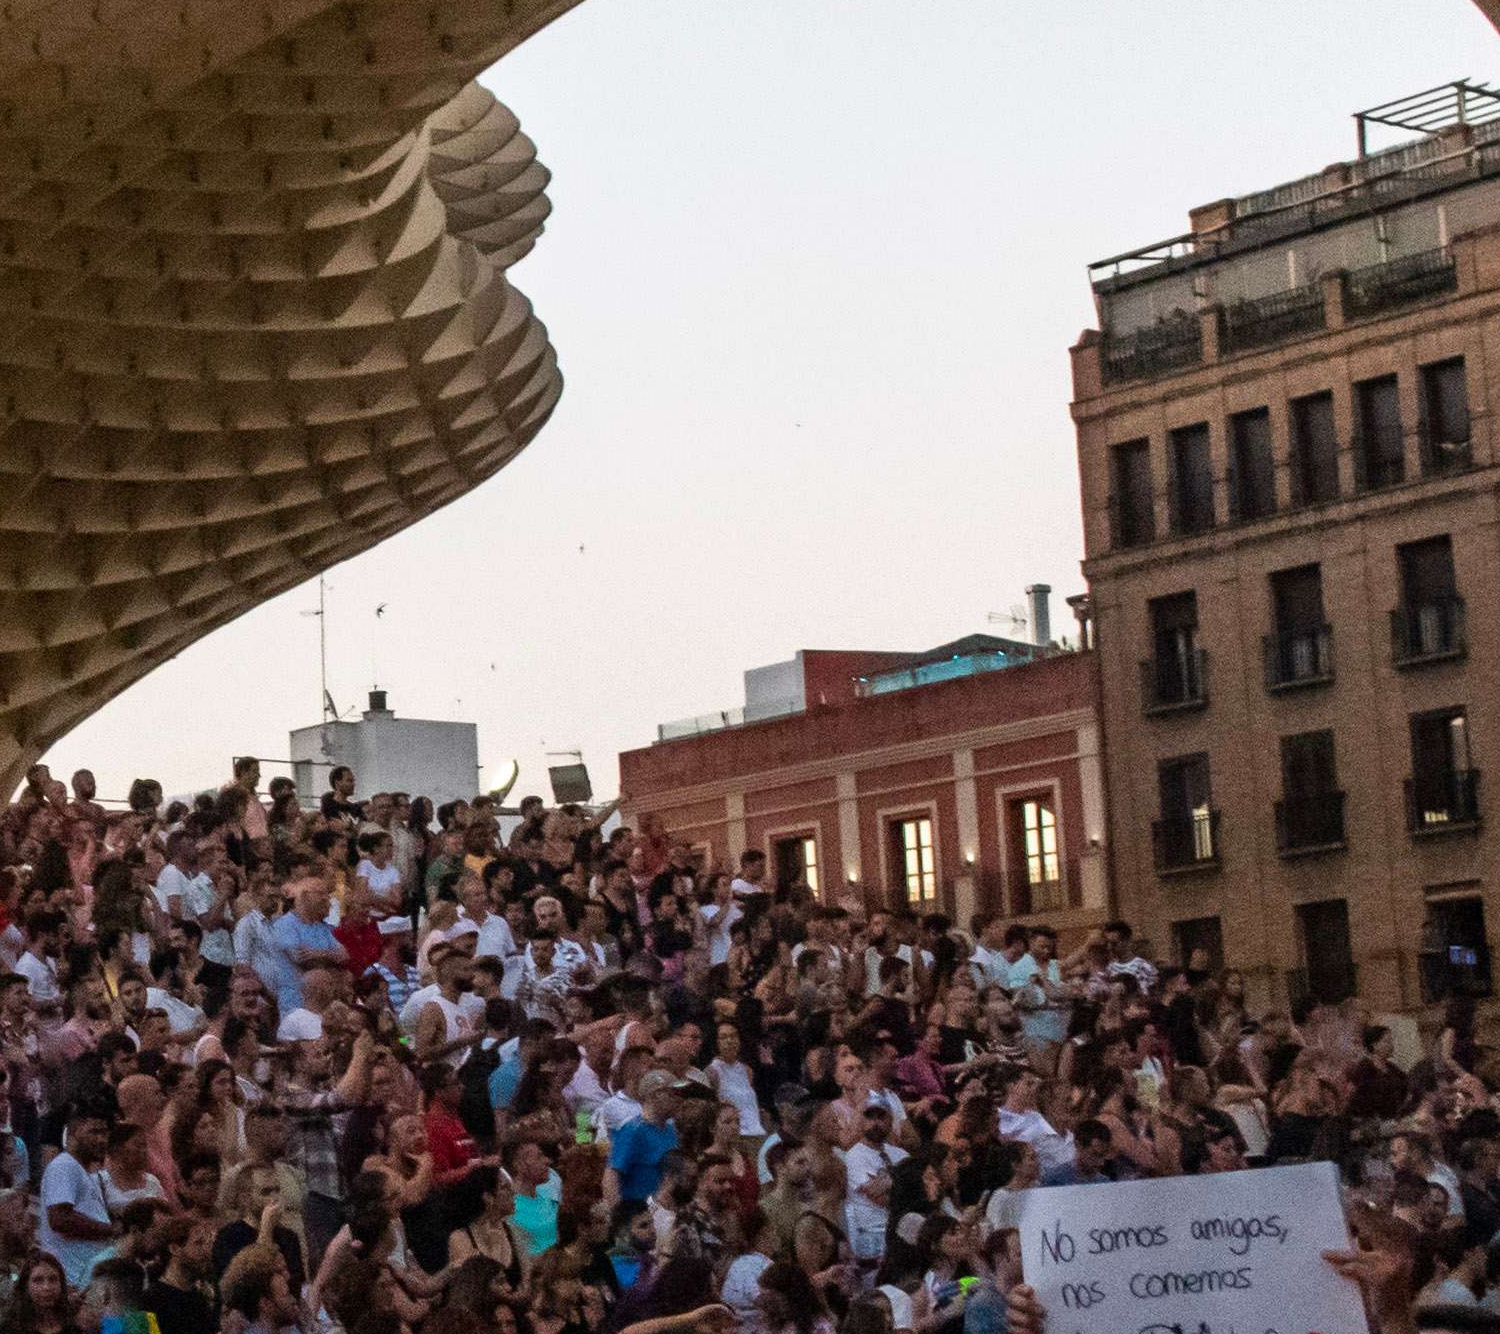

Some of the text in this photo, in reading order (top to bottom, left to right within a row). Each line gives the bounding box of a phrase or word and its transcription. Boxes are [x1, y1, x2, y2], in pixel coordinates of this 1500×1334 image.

[1041, 1214, 1289, 1264] No somos amigas,
[1061, 1281, 1106, 1309] nos
